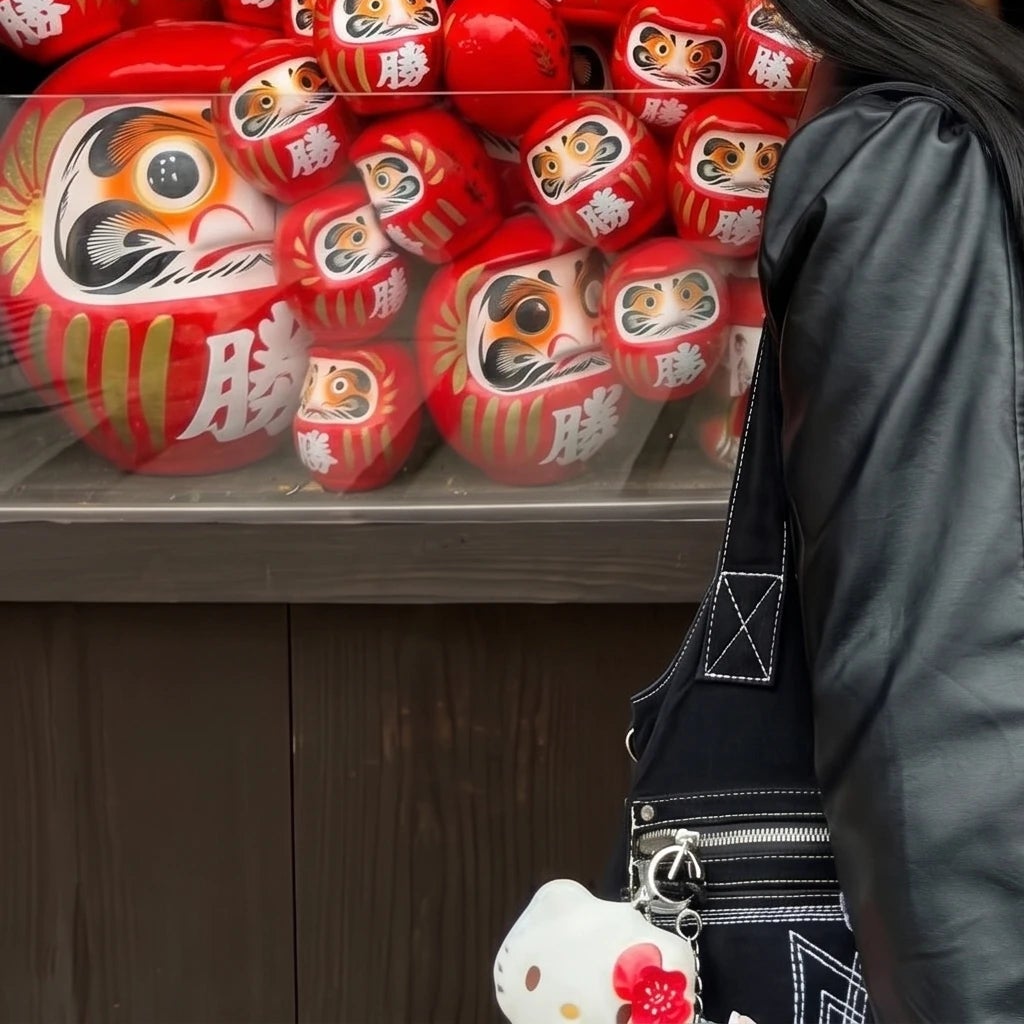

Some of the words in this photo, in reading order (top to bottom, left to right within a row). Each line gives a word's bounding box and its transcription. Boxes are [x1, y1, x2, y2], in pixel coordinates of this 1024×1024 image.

[376, 41, 429, 89] 勝
[286, 123, 339, 178] 勝
[177, 301, 312, 441] 勝
[539, 384, 622, 465] 勝
